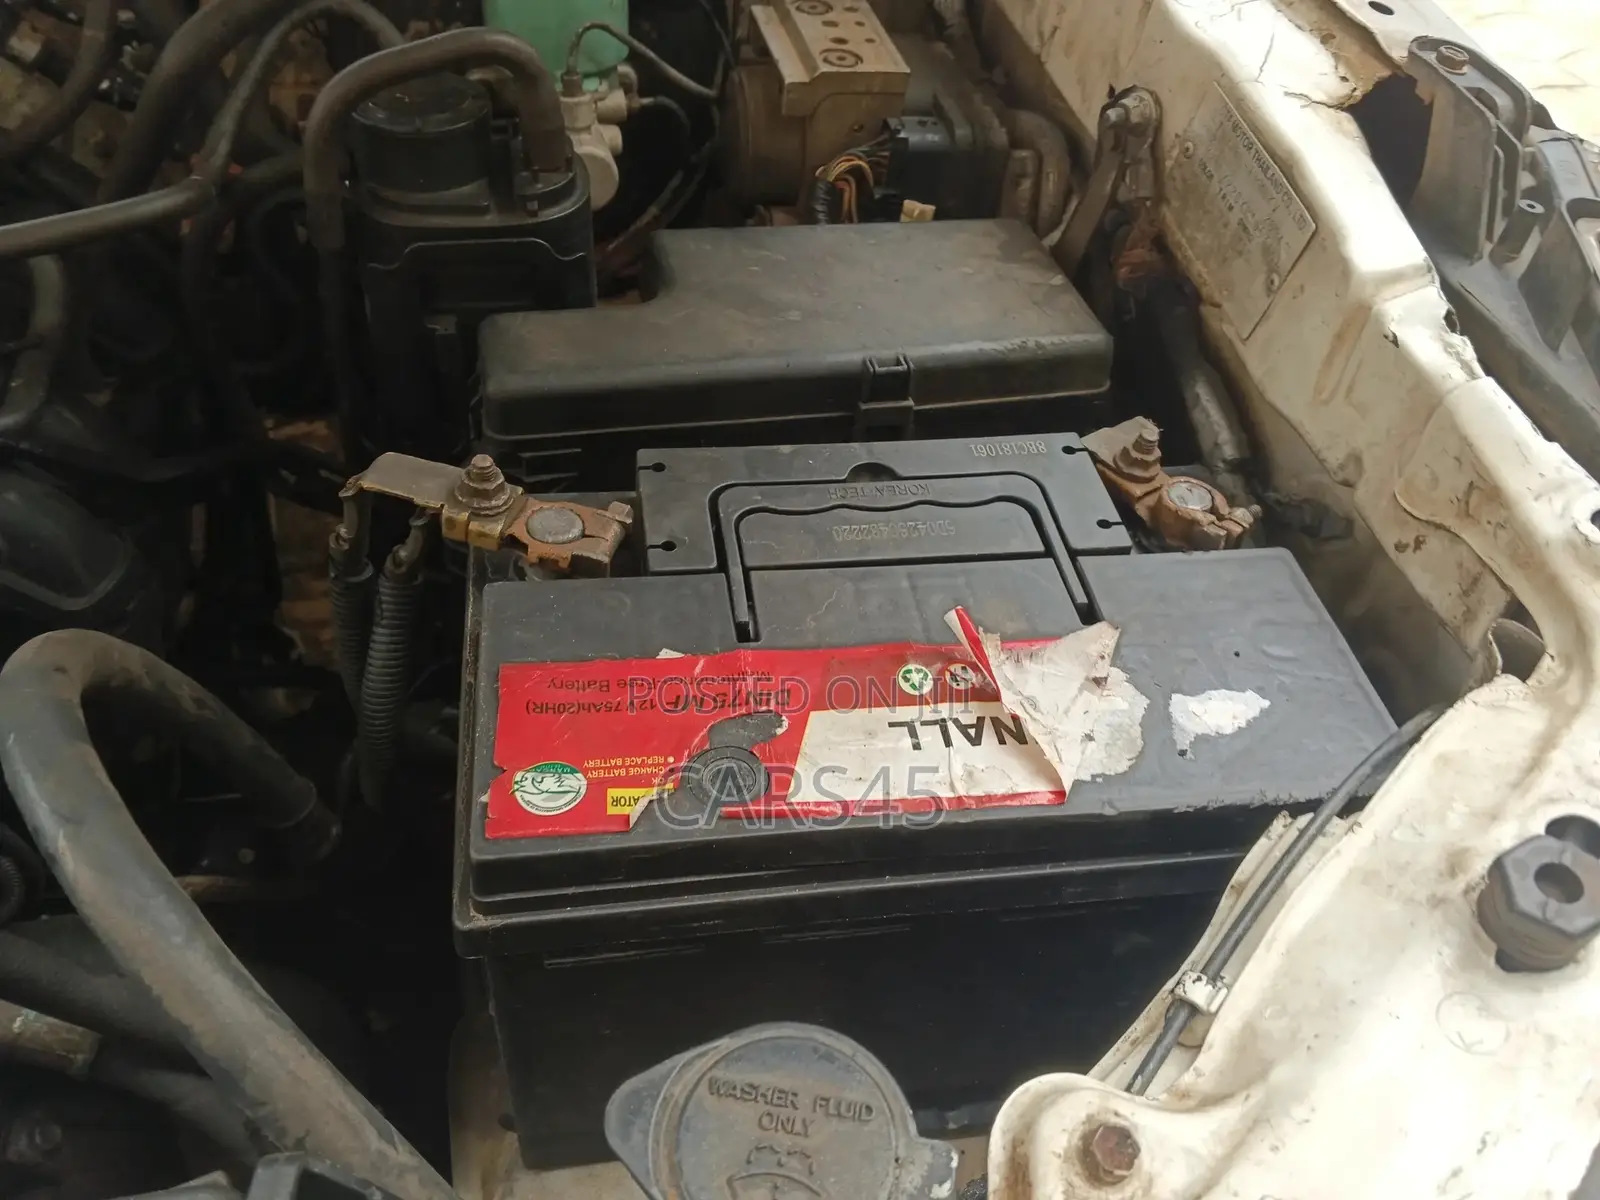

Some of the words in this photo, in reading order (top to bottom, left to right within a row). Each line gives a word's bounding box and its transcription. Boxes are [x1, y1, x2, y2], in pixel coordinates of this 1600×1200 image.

[827, 484, 869, 500] TECH
[874, 483, 931, 498] KOREA
[547, 676, 610, 693] Battery
[526, 699, 621, 715] 75Ah(20HR)
[887, 716, 1038, 750] NALL
[583, 757, 622, 768] BATTERY
[624, 756, 665, 767] REPLACE
[586, 768, 626, 779] BATTERY
[628, 765, 665, 776] CHARGE
[611, 795, 643, 807] ATOR
[708, 1076, 799, 1110] WASHER
[813, 1095, 876, 1123] FLUID
[757, 1110, 816, 1138] ONLY
